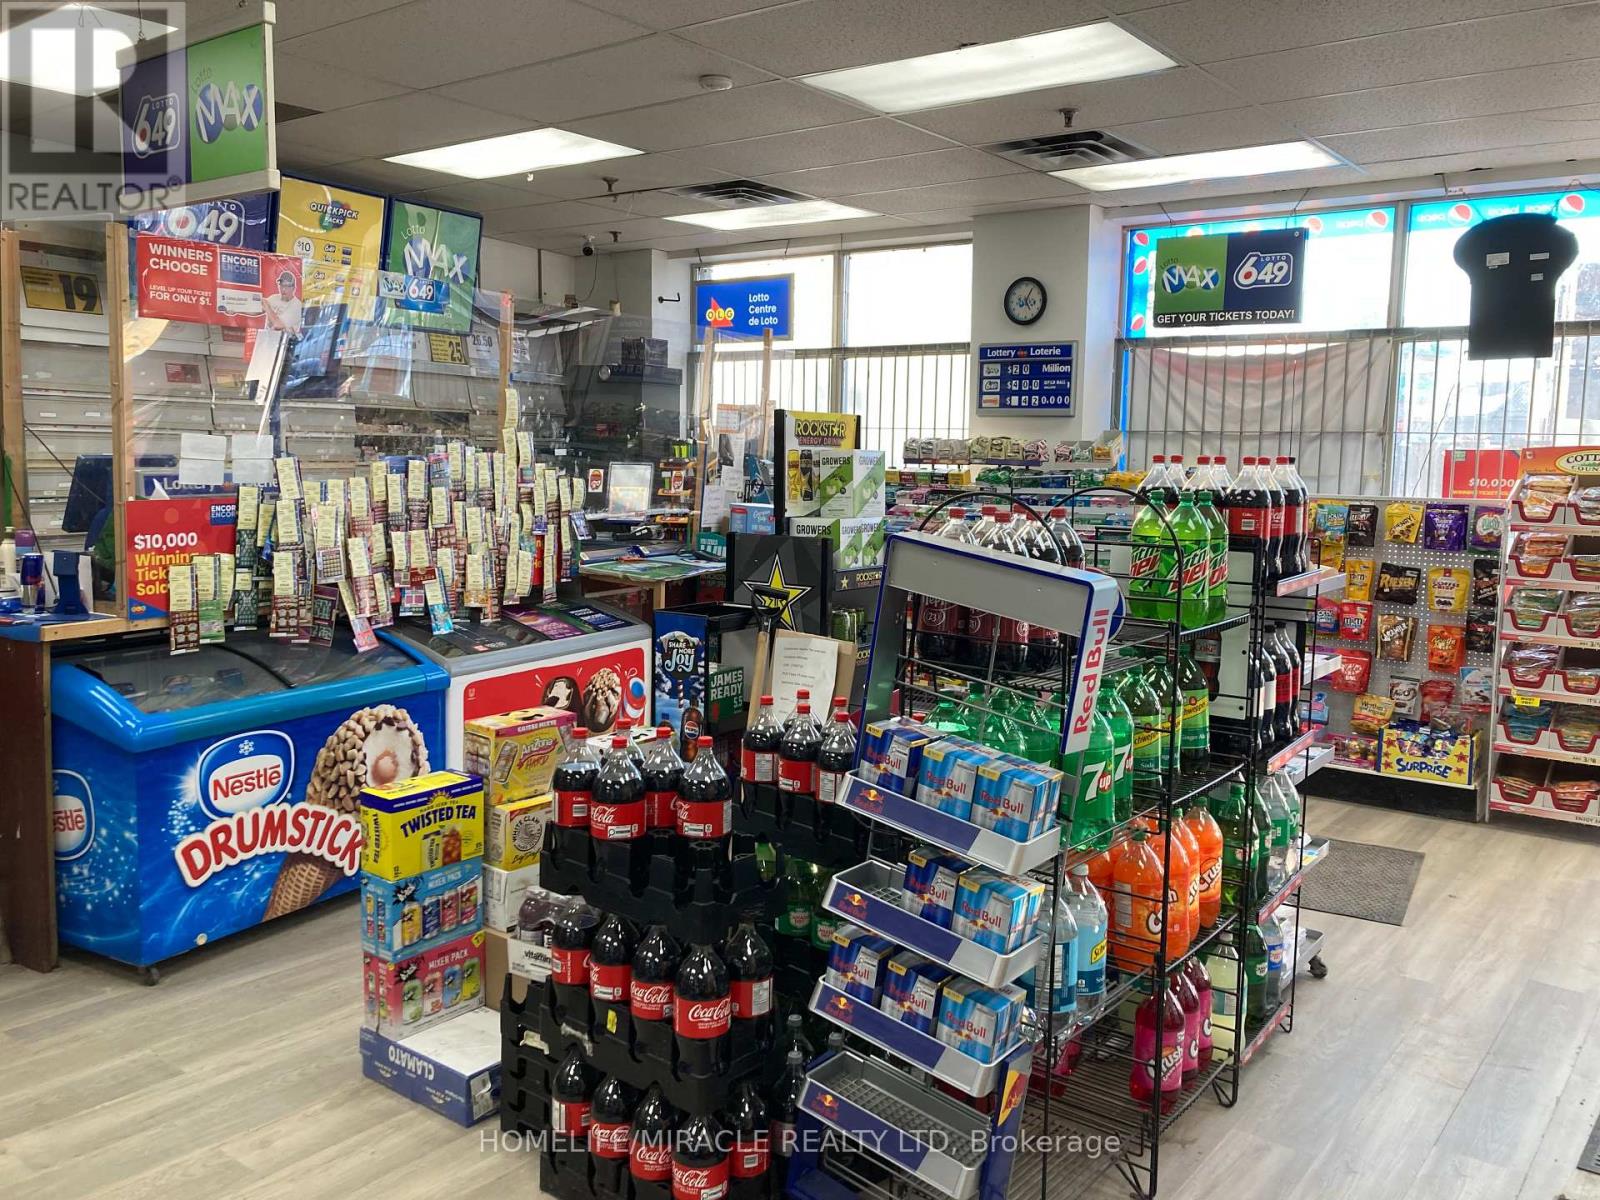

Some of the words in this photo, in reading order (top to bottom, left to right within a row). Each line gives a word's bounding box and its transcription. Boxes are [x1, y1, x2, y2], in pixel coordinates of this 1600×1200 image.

[198, 81, 261, 143] MAX
[149, 243, 213, 262] WINNERS
[221, 255, 259, 267] ENCORE
[404, 238, 467, 284] MAX
[1261, 254, 1287, 263] LOTTO
[150, 258, 208, 276] CHOOSE
[1163, 265, 1219, 294] MAX
[60, 275, 98, 311] 19
[150, 285, 167, 293] LEVEL
[194, 289, 211, 297] TICKET
[150, 292, 166, 300] FOR
[172, 294, 197, 304] ONLY
[748, 293, 770, 302] Lotto
[748, 305, 777, 314] Centre
[1157, 314, 1178, 325] GET
[1180, 312, 1207, 323] YOUR
[1210, 311, 1253, 322] TICKETS
[1256, 309, 1296, 320] TODAY!
[748, 317, 759, 326] de
[760, 317, 778, 325] Loto
[987, 349, 1017, 358] Lottery
[1030, 347, 1061, 356] Loterie
[1042, 363, 1071, 373] Million
[821, 456, 851, 465] GROWERS
[797, 525, 832, 535] GROWERS
[134, 532, 198, 551] $10,000
[136, 568, 169, 581] Tick
[668, 641, 687, 649] SHARE
[665, 649, 696, 673] Joy
[710, 670, 744, 688] JAMES
[1074, 676, 1097, 734] Red
[1086, 608, 1110, 669] Bull
[711, 682, 744, 701] READY
[884, 754, 902, 769] Bull
[213, 764, 282, 802] Nestlé
[946, 776, 966, 794] Bull
[1003, 798, 1024, 814] Bull
[400, 807, 454, 838] TWISTED
[456, 804, 477, 820] TEA
[180, 809, 366, 882] DRUMSTICK
[928, 885, 948, 902] Bull
[961, 902, 982, 918] Red
[982, 910, 1002, 928] Bull
[428, 956, 450, 969] MIXER
[450, 948, 468, 961] PACK
[852, 965, 870, 980] Bull
[909, 994, 928, 1011] Bull
[946, 1011, 967, 1028] Red
[966, 1021, 987, 1038] Bull
[388, 1044, 435, 1081] CLAMATO
